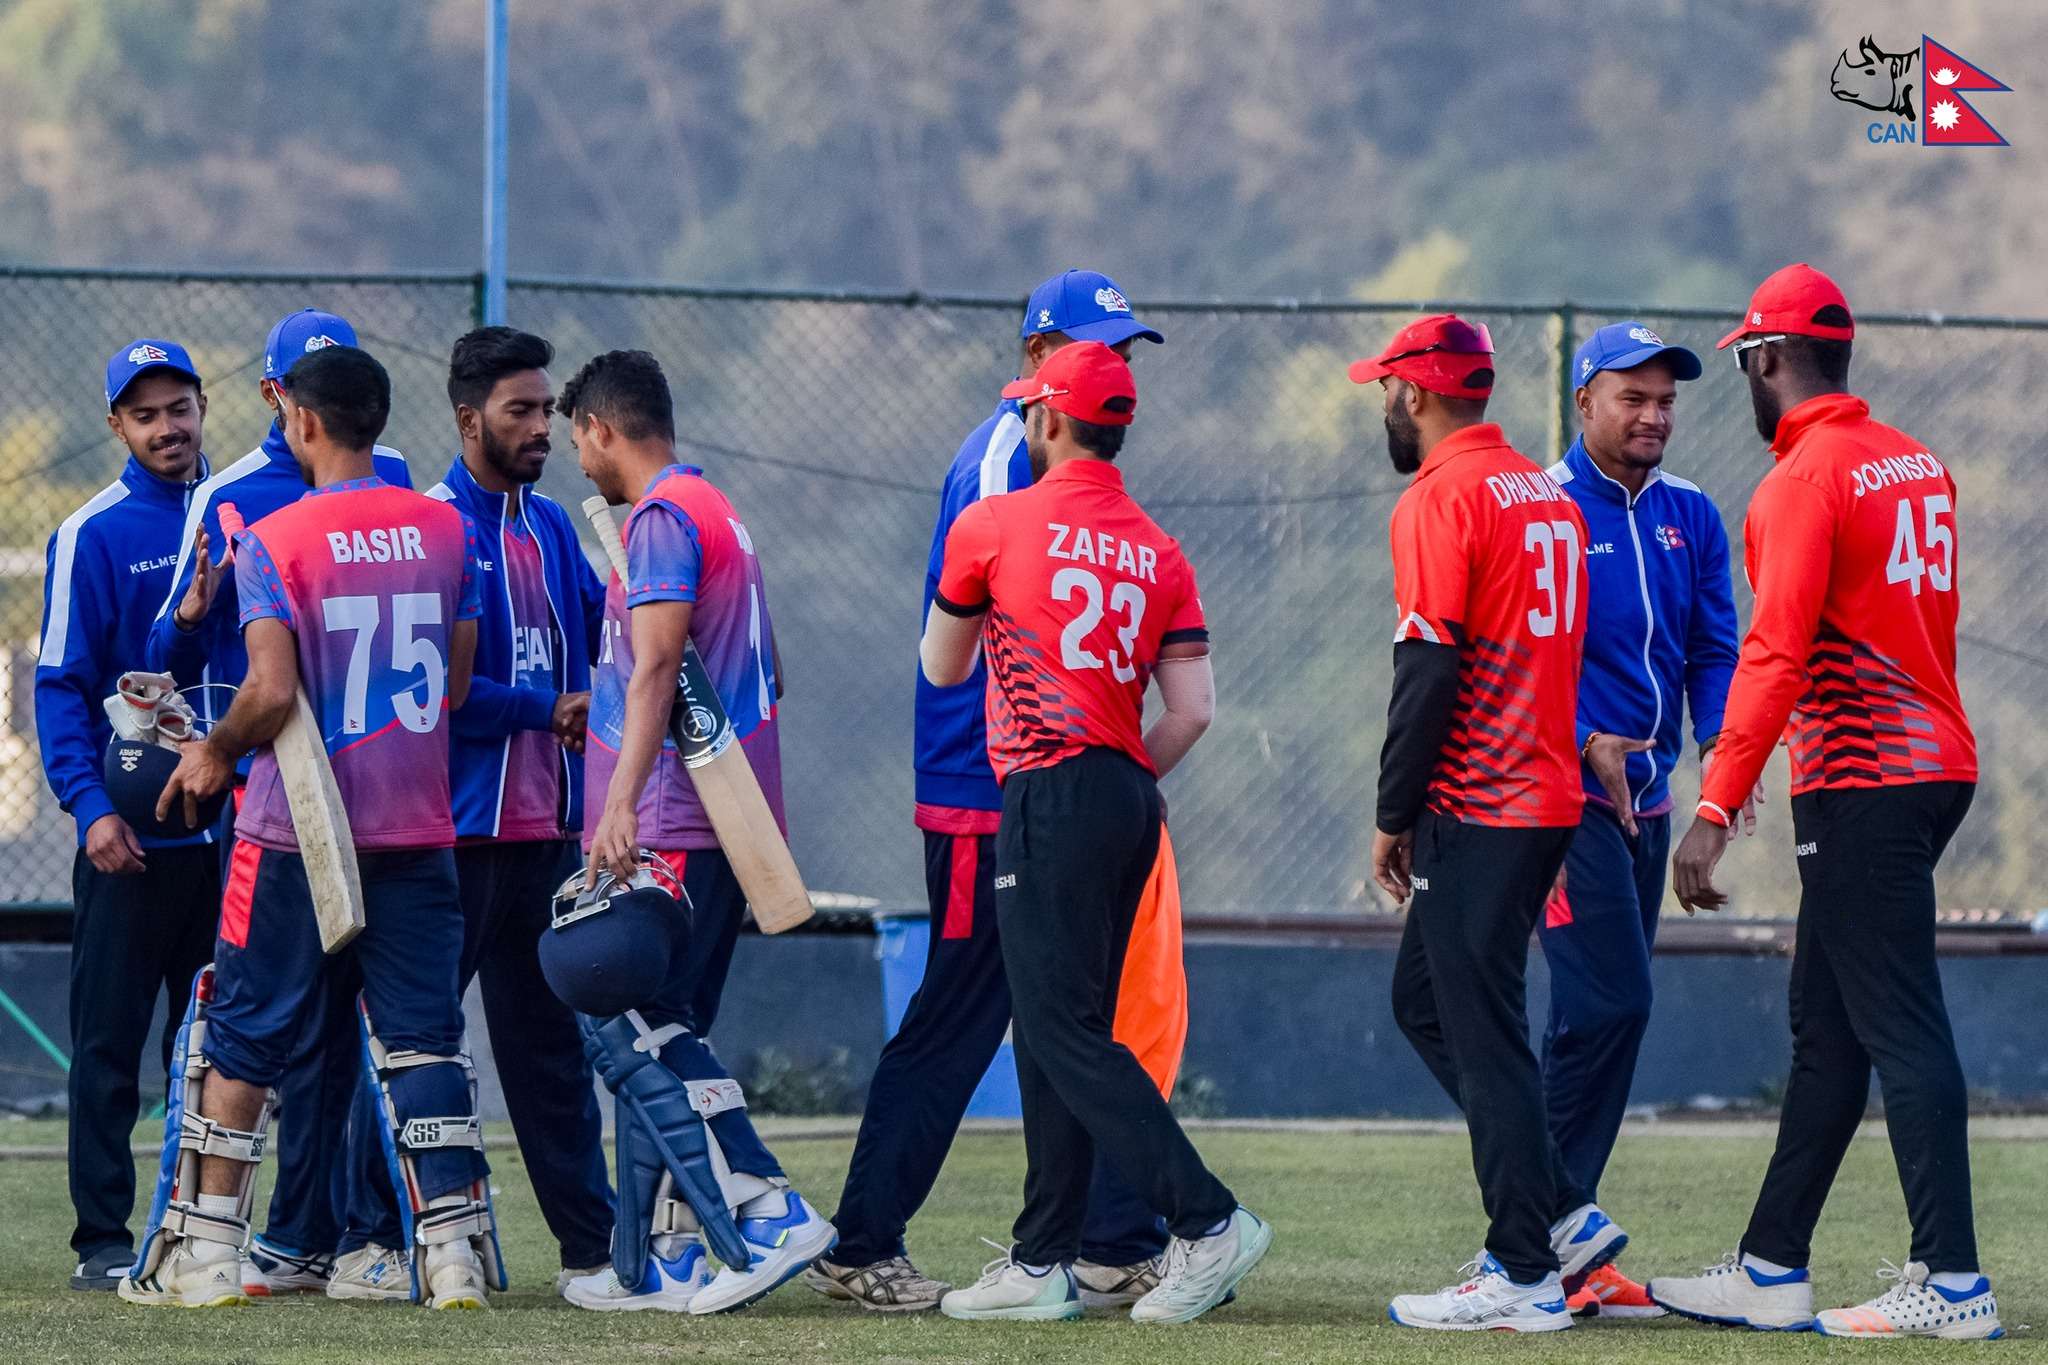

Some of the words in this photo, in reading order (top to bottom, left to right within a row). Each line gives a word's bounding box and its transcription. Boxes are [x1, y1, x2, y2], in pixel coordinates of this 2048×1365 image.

[129, 554, 178, 574] KELME
[326, 526, 426, 564] BASIR
[1047, 522, 1157, 585] ZAFAR
[1585, 543, 1614, 555] LME
[1886, 494, 1953, 597] 45
[1524, 520, 1580, 638] 37
[1051, 567, 1147, 684] 23
[321, 592, 445, 734] 75
[413, 1122, 441, 1143] SS
